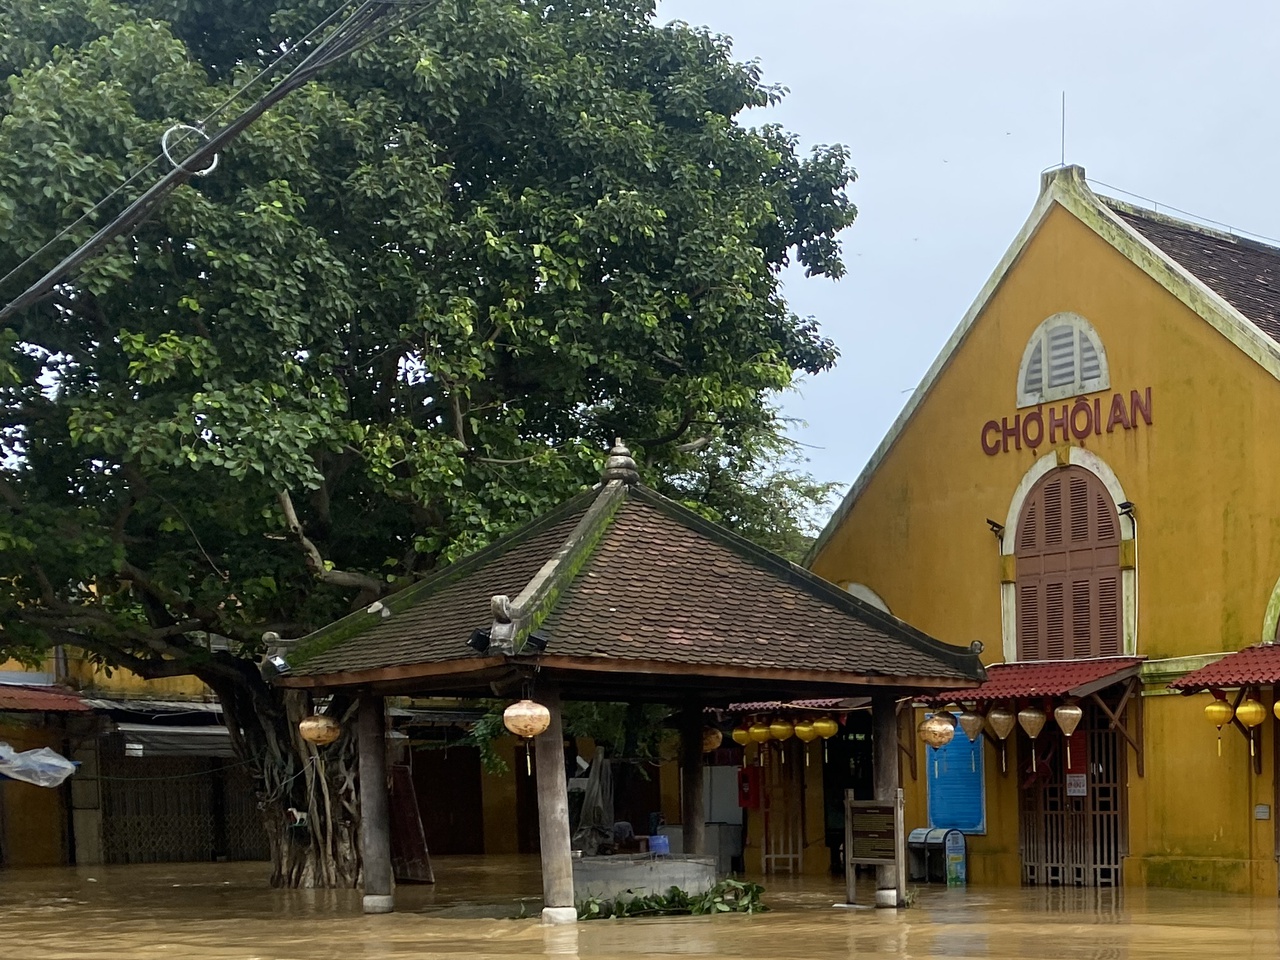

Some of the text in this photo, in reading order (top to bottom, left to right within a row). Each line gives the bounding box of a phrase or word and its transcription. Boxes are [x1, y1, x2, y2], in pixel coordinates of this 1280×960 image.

[981, 387, 1153, 456] CHỢ HỘI AN
